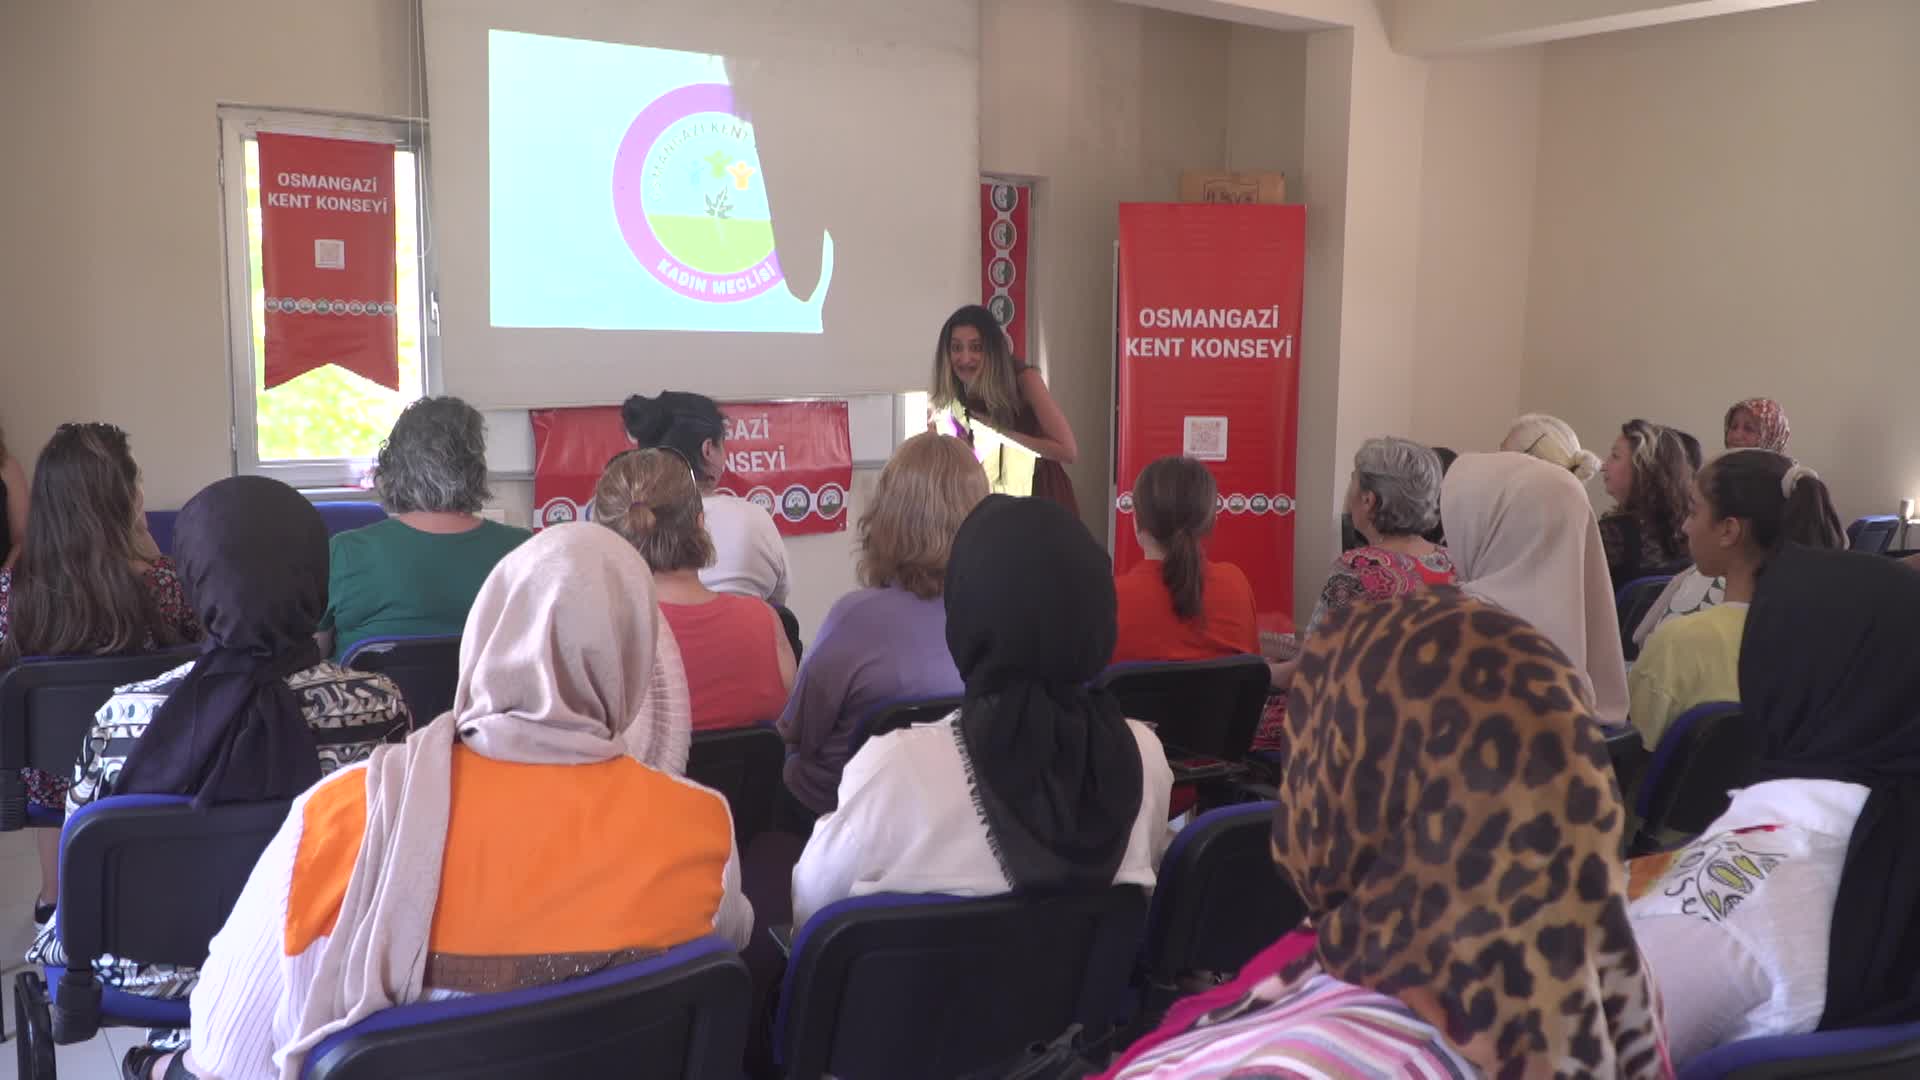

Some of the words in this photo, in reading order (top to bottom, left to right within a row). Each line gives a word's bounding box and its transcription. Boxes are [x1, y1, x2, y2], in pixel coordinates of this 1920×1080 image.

[277, 172, 378, 193] OSMANGAZİ
[267, 192, 313, 209] KENT
[316, 196, 389, 215] KONSEYİ
[657, 258, 708, 293] KADIN
[1139, 304, 1280, 329] OSMANGAZİ
[1125, 336, 1185, 357] KENT
[1190, 335, 1294, 360] KONSEYİ
[722, 444, 787, 473] NSEYİ
